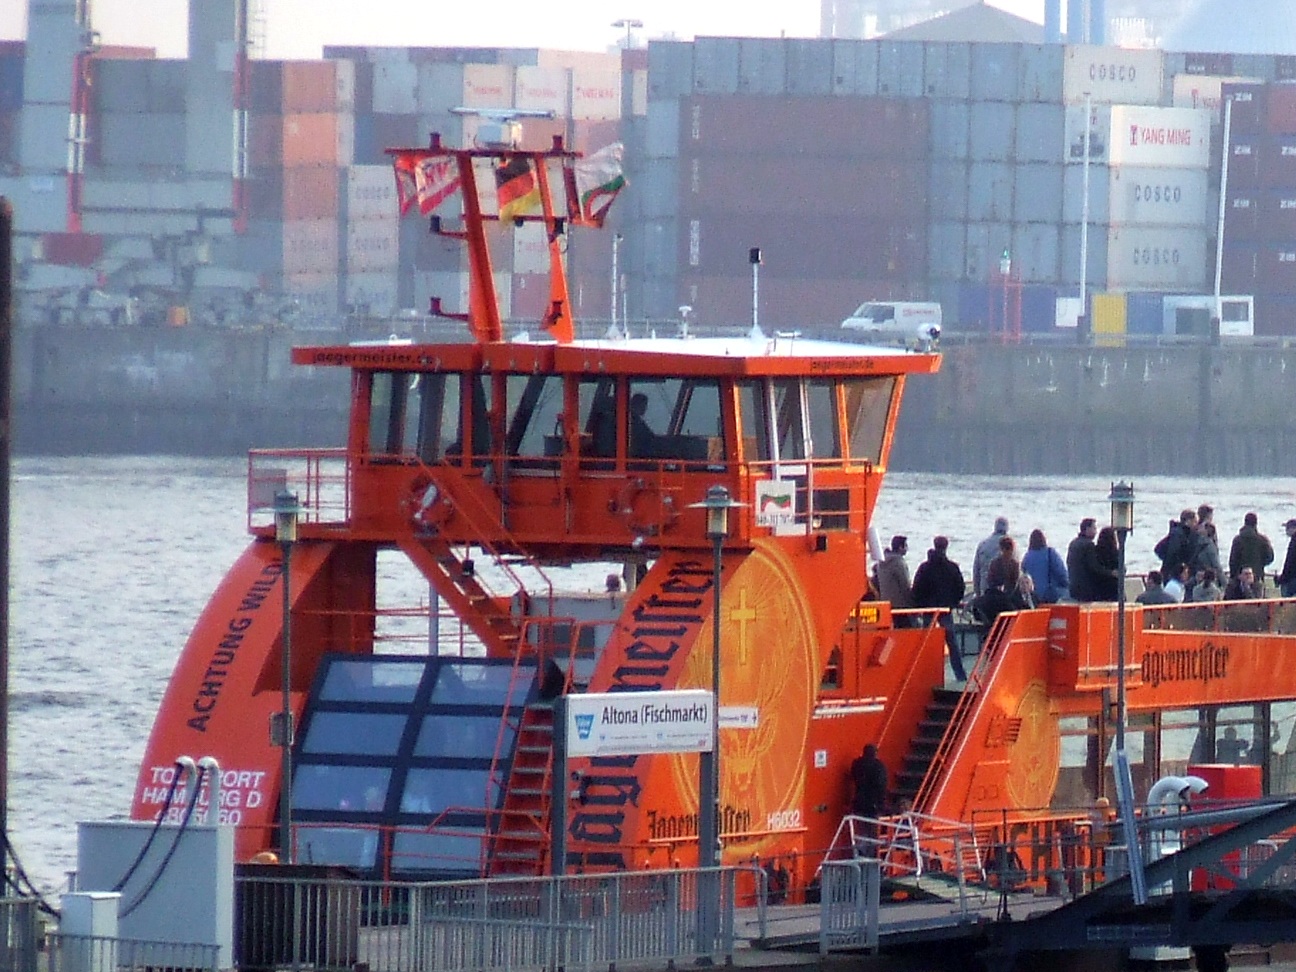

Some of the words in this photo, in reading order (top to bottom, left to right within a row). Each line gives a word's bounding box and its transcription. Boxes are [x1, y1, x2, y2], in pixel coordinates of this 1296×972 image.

[1089, 63, 1137, 82] COSCO
[1141, 128, 1165, 145] YANG
[1167, 129, 1191, 146] MING
[1135, 184, 1182, 203] COSCO
[1133, 248, 1180, 265] COSCO
[186, 616, 253, 733] ACHTUNG
[601, 705, 638, 725] Altona
[640, 702, 708, 726] (Fischmarkt)
[246, 789, 262, 809] D
[767, 809, 800, 831] H6032
